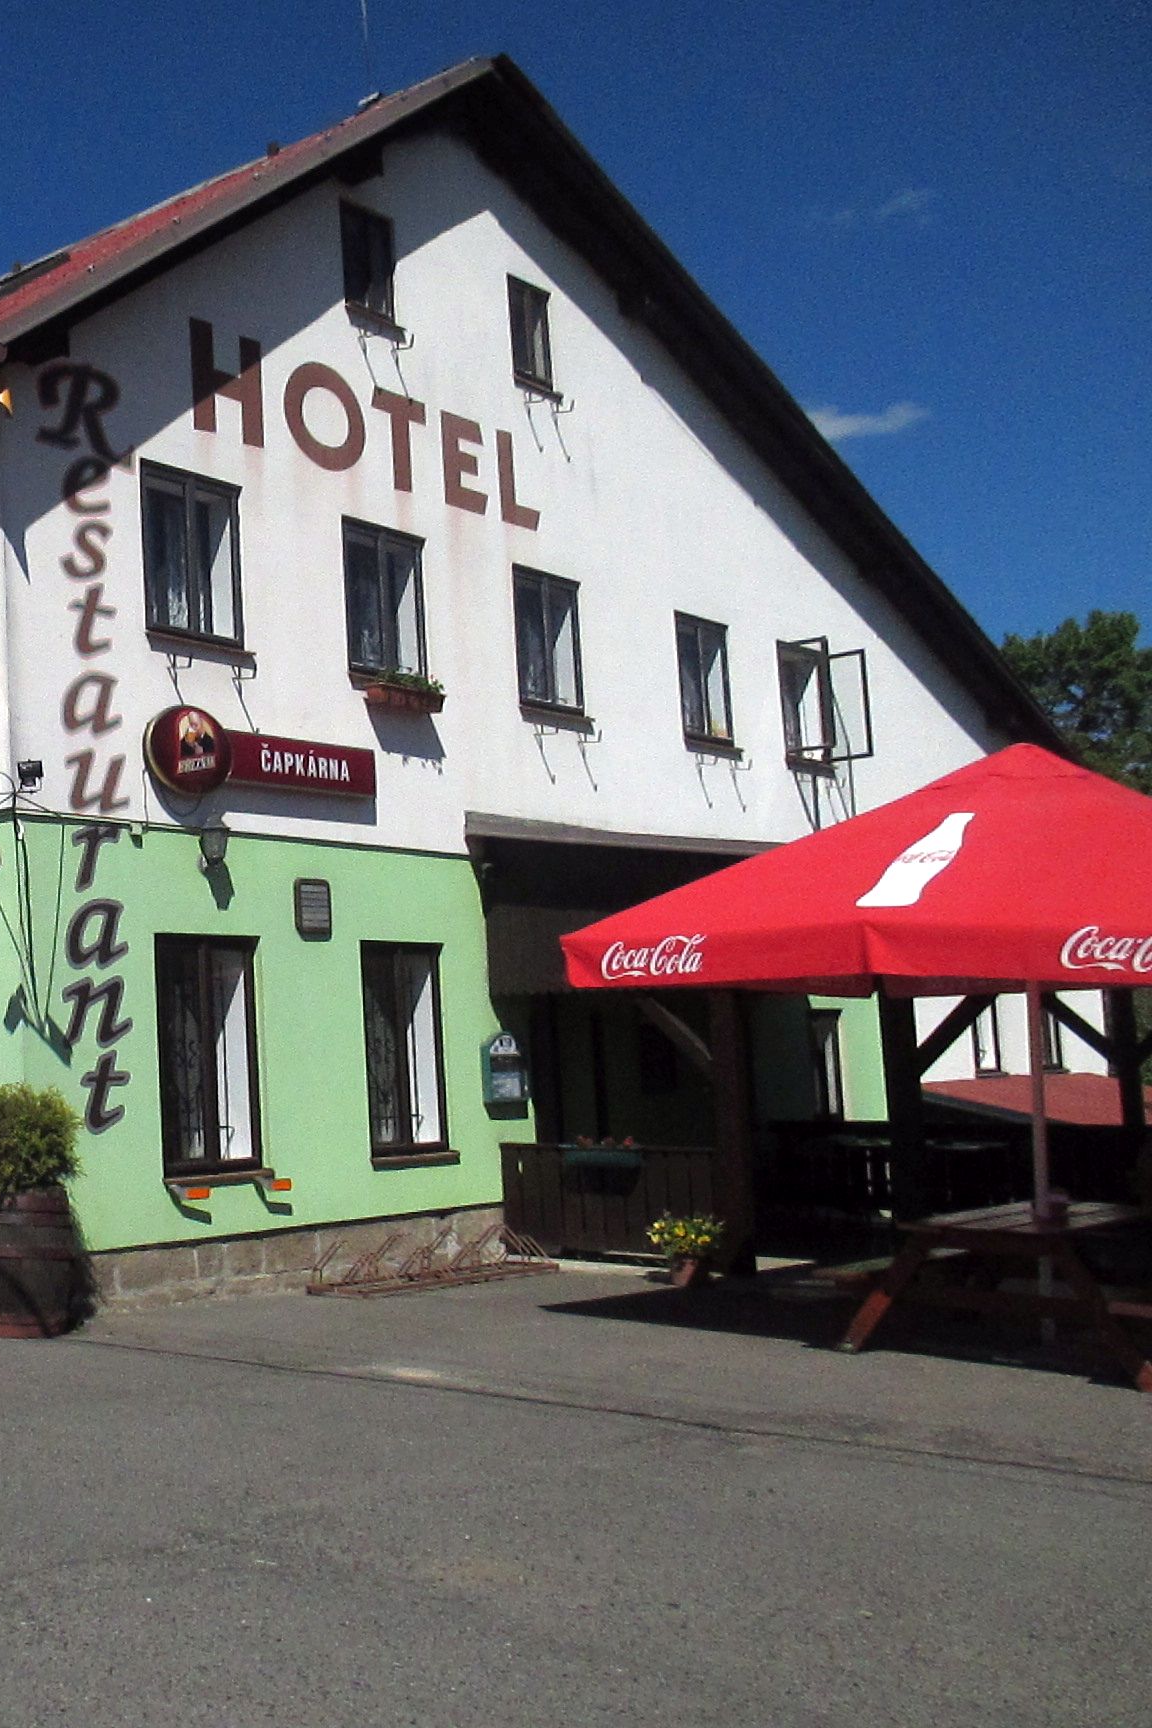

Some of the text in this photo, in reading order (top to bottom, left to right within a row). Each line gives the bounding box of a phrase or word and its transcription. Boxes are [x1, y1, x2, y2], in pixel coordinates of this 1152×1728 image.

[189, 317, 541, 532] HOTEL
[35, 357, 135, 1136] Restaurant
[261, 742, 350, 782] ČAPKÁRNA
[601, 933, 707, 980] Coca-Cola
